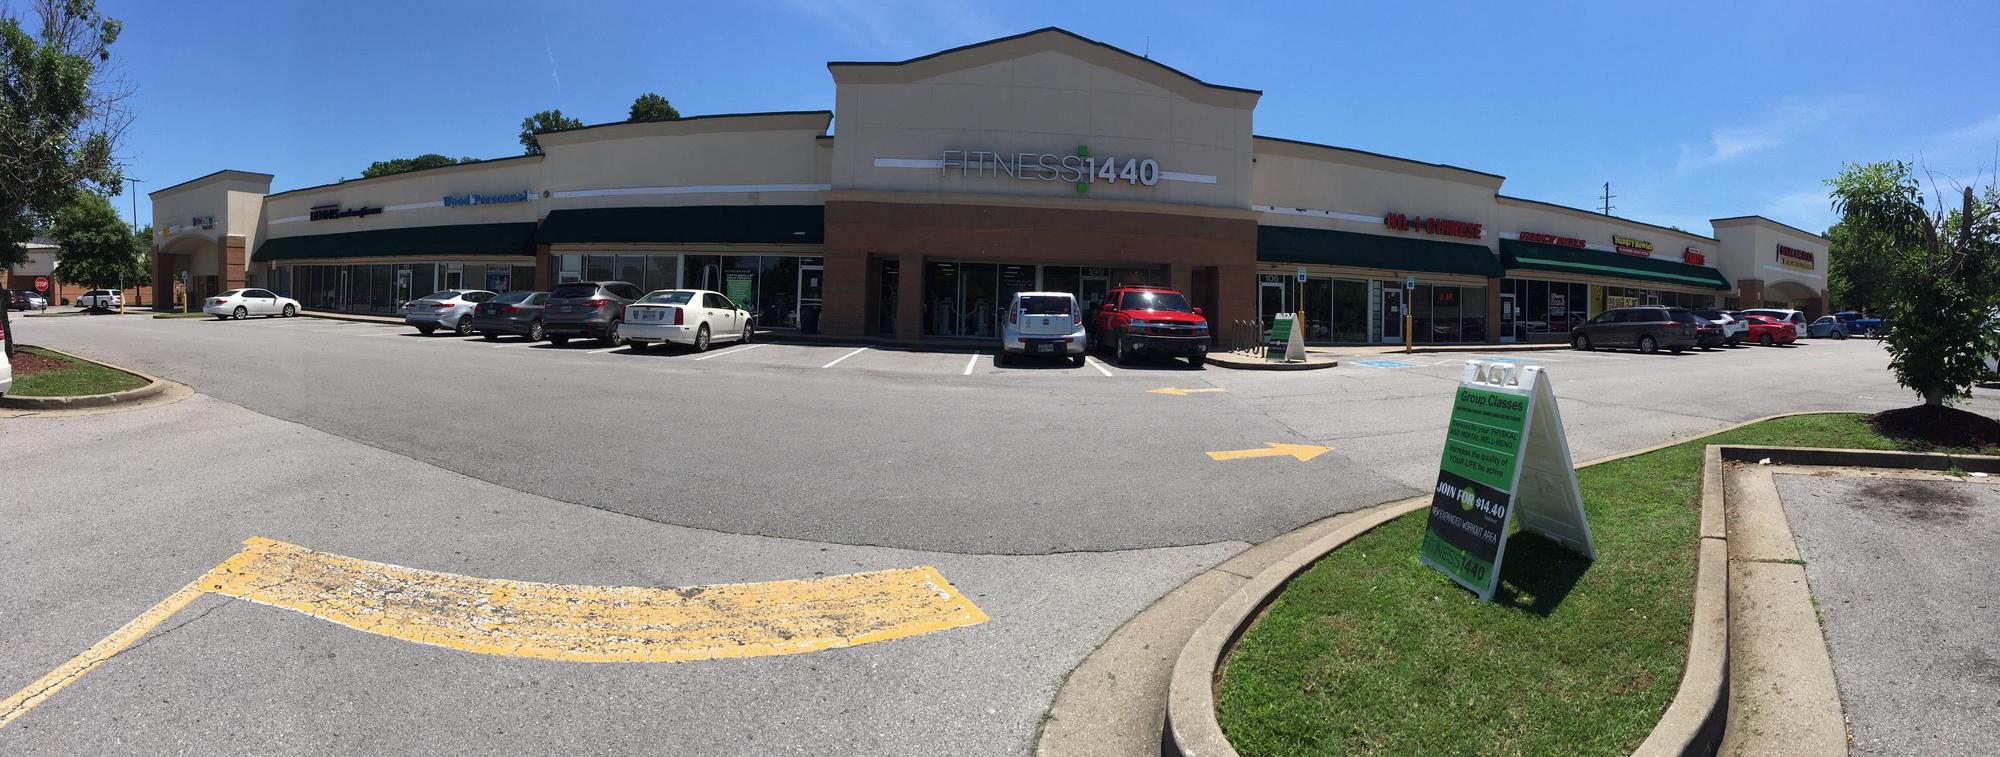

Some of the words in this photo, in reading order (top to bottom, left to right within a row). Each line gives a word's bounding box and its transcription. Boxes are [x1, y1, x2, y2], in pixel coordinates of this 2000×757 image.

[1426, 217, 1483, 240] CHINESE
[1265, 275, 1280, 283] 106
[1461, 390, 1486, 408] Group
[1488, 394, 1524, 412] Classes
[1460, 430, 1479, 442] MENTAL
[1449, 455, 1464, 466] YOUR
[1465, 460, 1477, 470] LIFE
[1480, 454, 1500, 466] quality
[1500, 458, 1508, 466] of
[1436, 481, 1457, 499] JOIN
[1456, 489, 1475, 505] FOR
[1475, 496, 1505, 519] $14.40
[1440, 509, 1462, 528] EXPANDED
[1461, 519, 1484, 538] WORKOUT
[1484, 530, 1497, 543] AREA
